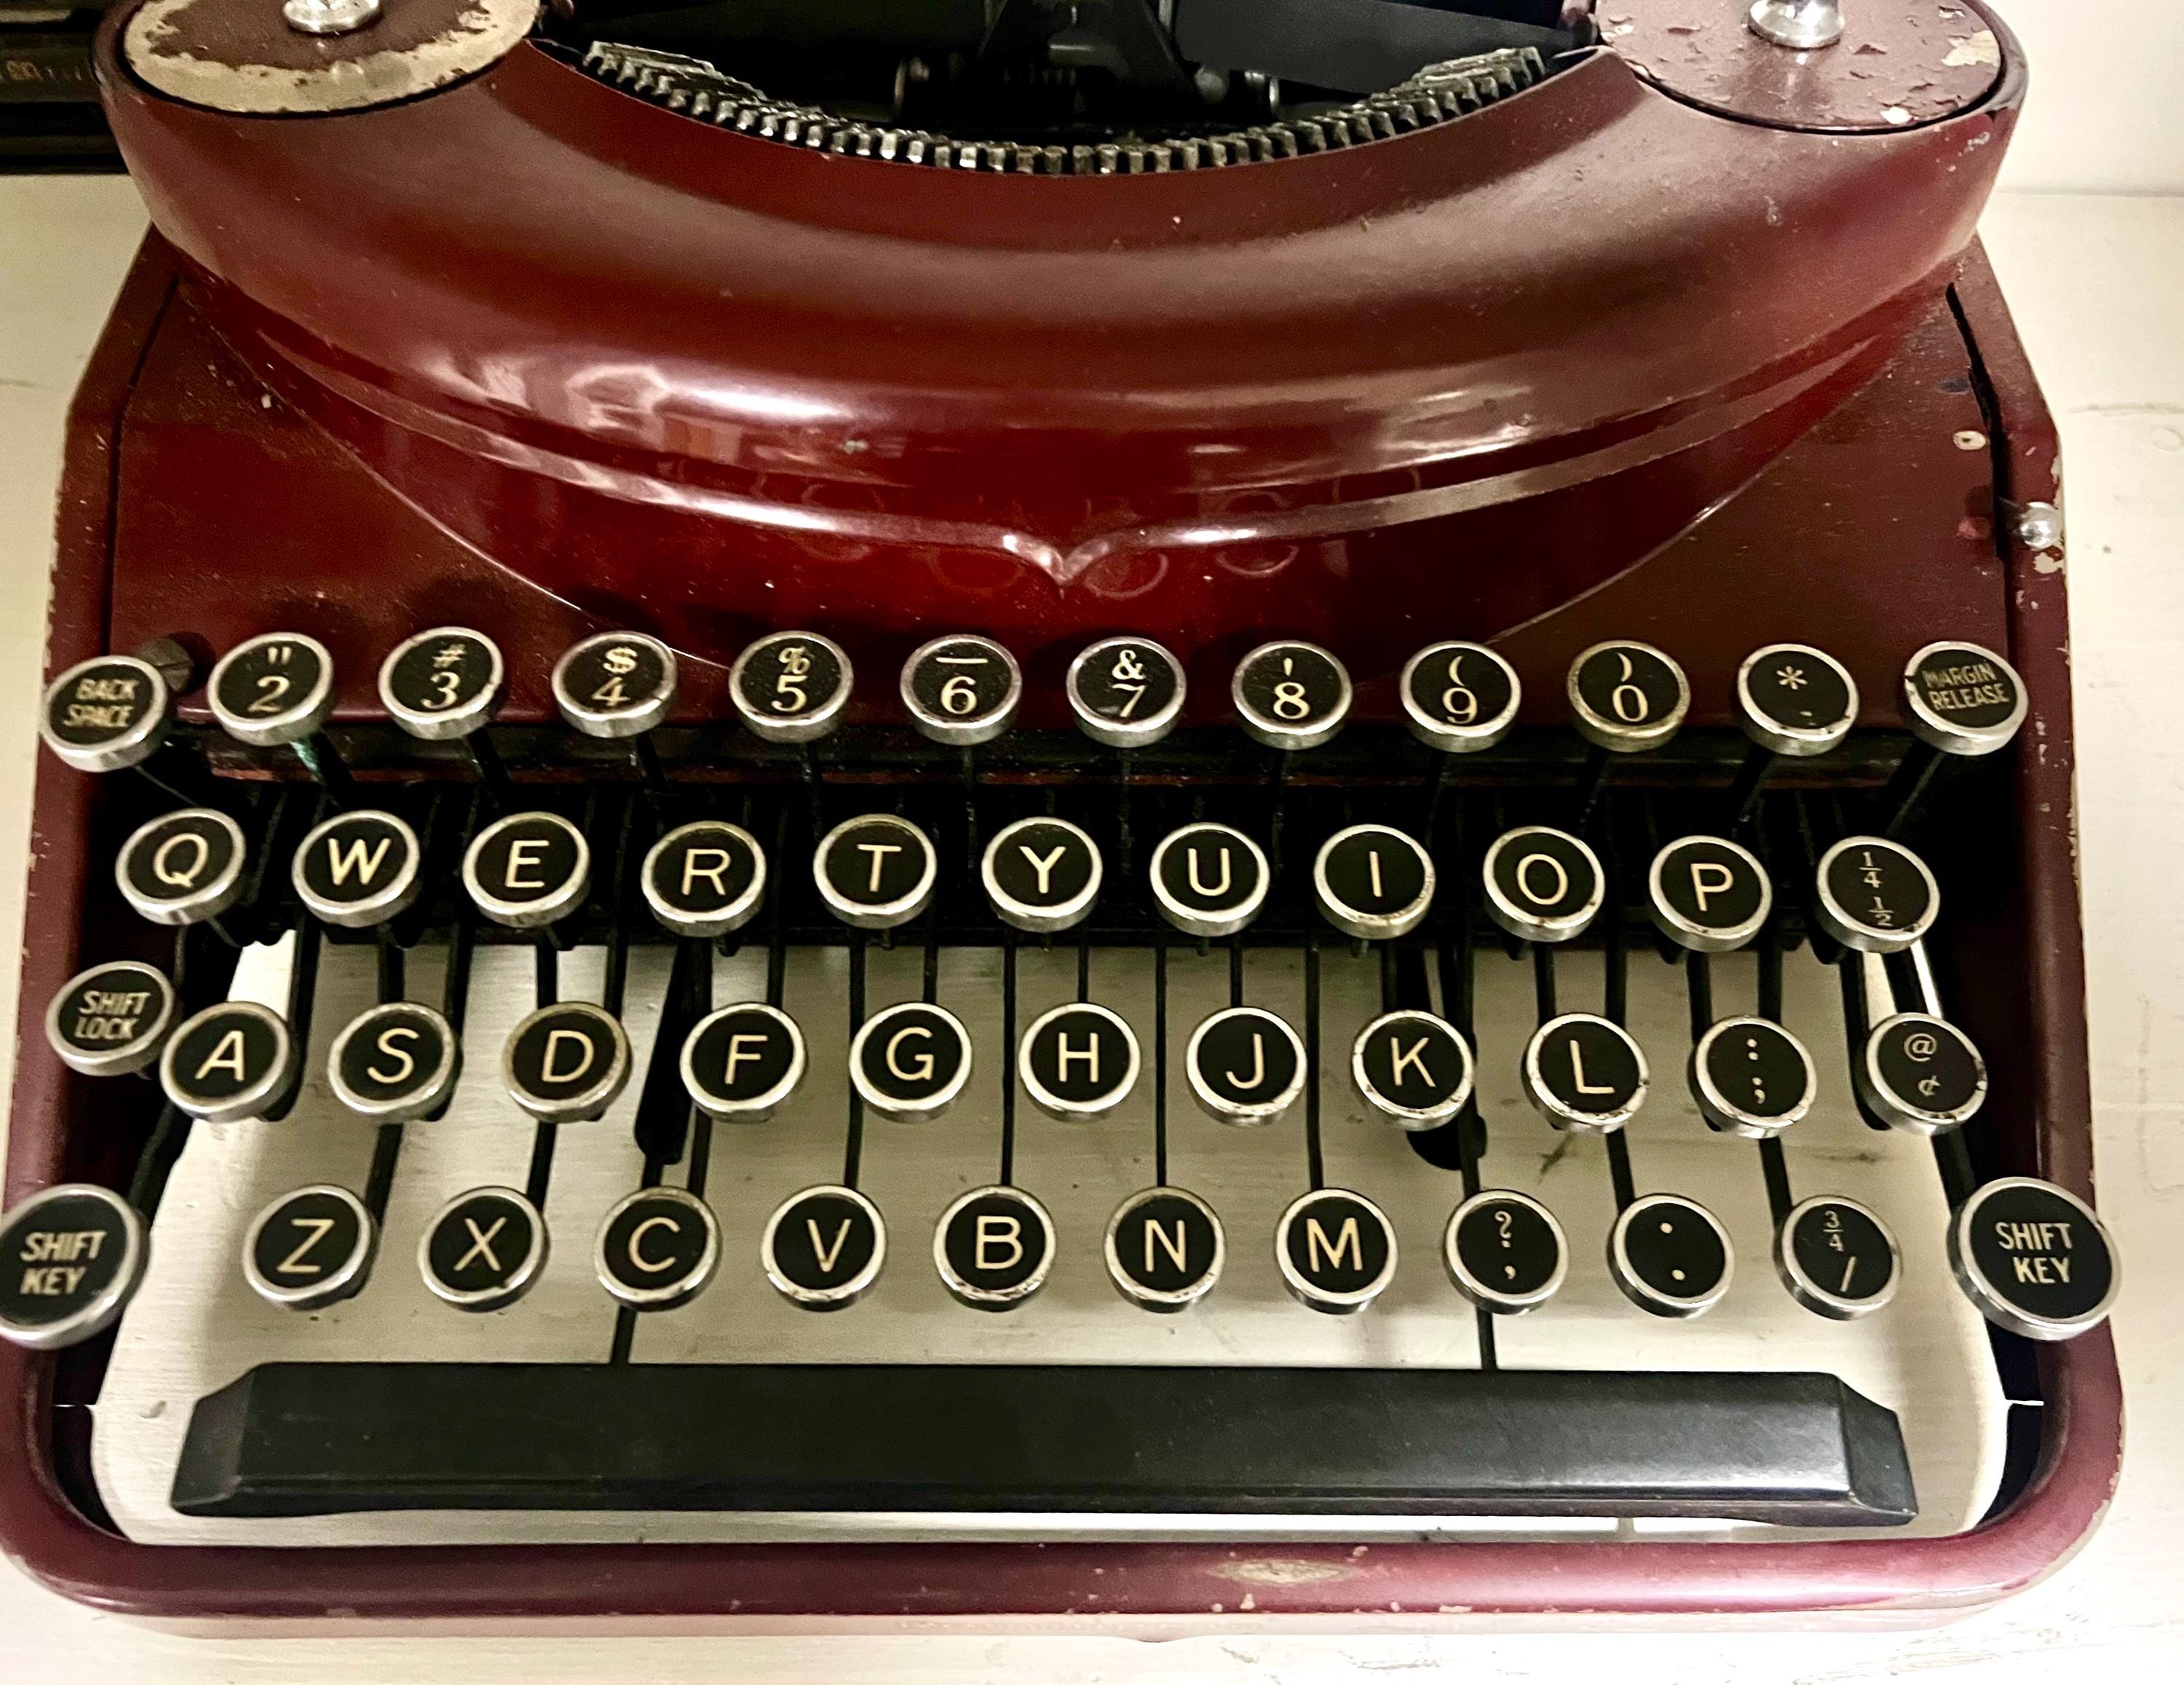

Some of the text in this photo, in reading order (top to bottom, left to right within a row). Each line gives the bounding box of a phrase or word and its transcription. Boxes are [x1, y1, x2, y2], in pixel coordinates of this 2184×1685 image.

[432, 644, 466, 668] #
[603, 647, 638, 674] $
[1112, 649, 1146, 680] &
[1922, 662, 1997, 688] MARGIN
[75, 678, 140, 701] BACK
[248, 676, 290, 713] 2
[422, 671, 460, 709] 3
[592, 676, 630, 706] 4
[771, 674, 808, 712] 5
[941, 676, 977, 714] 6
[1112, 683, 1144, 718] 7
[1273, 682, 1310, 719] 8
[1441, 687, 1477, 724] 9
[1928, 683, 2009, 711] RELEASE
[63, 703, 134, 727] SPACE
[154, 833, 209, 888] Q
[328, 837, 391, 885] W
[505, 840, 550, 888] E
[681, 848, 731, 896] R
[857, 843, 902, 892] T
[1018, 845, 1067, 893] Y
[1187, 848, 1231, 896] U
[1690, 863, 1733, 912] P
[79, 990, 151, 1015] SHIFT
[74, 1017, 138, 1040] LOCK
[1904, 1033, 1937, 1062] @
[195, 1030, 245, 1081] A
[367, 1027, 419, 1084] S
[542, 1030, 594, 1083] D
[724, 1034, 768, 1084] F
[886, 1027, 934, 1081] G
[1059, 1032, 1099, 1083] H
[1226, 1033, 1264, 1089] J
[1390, 1037, 1436, 1087] K
[1570, 1040, 1615, 1094] L
[20, 1230, 107, 1261] SHIFT
[277, 1218, 335, 1273] Z
[454, 1217, 506, 1271] X
[628, 1217, 680, 1272] C
[807, 1218, 852, 1272] V
[976, 1215, 1023, 1270] B
[1145, 1219, 1186, 1273] N
[1307, 1218, 1363, 1272] M
[1495, 1210, 1512, 1248] ?
[1995, 1222, 2072, 1250] SHIFT
[20, 1266, 86, 1295] KEY
[2013, 1256, 2070, 1284] KEY
